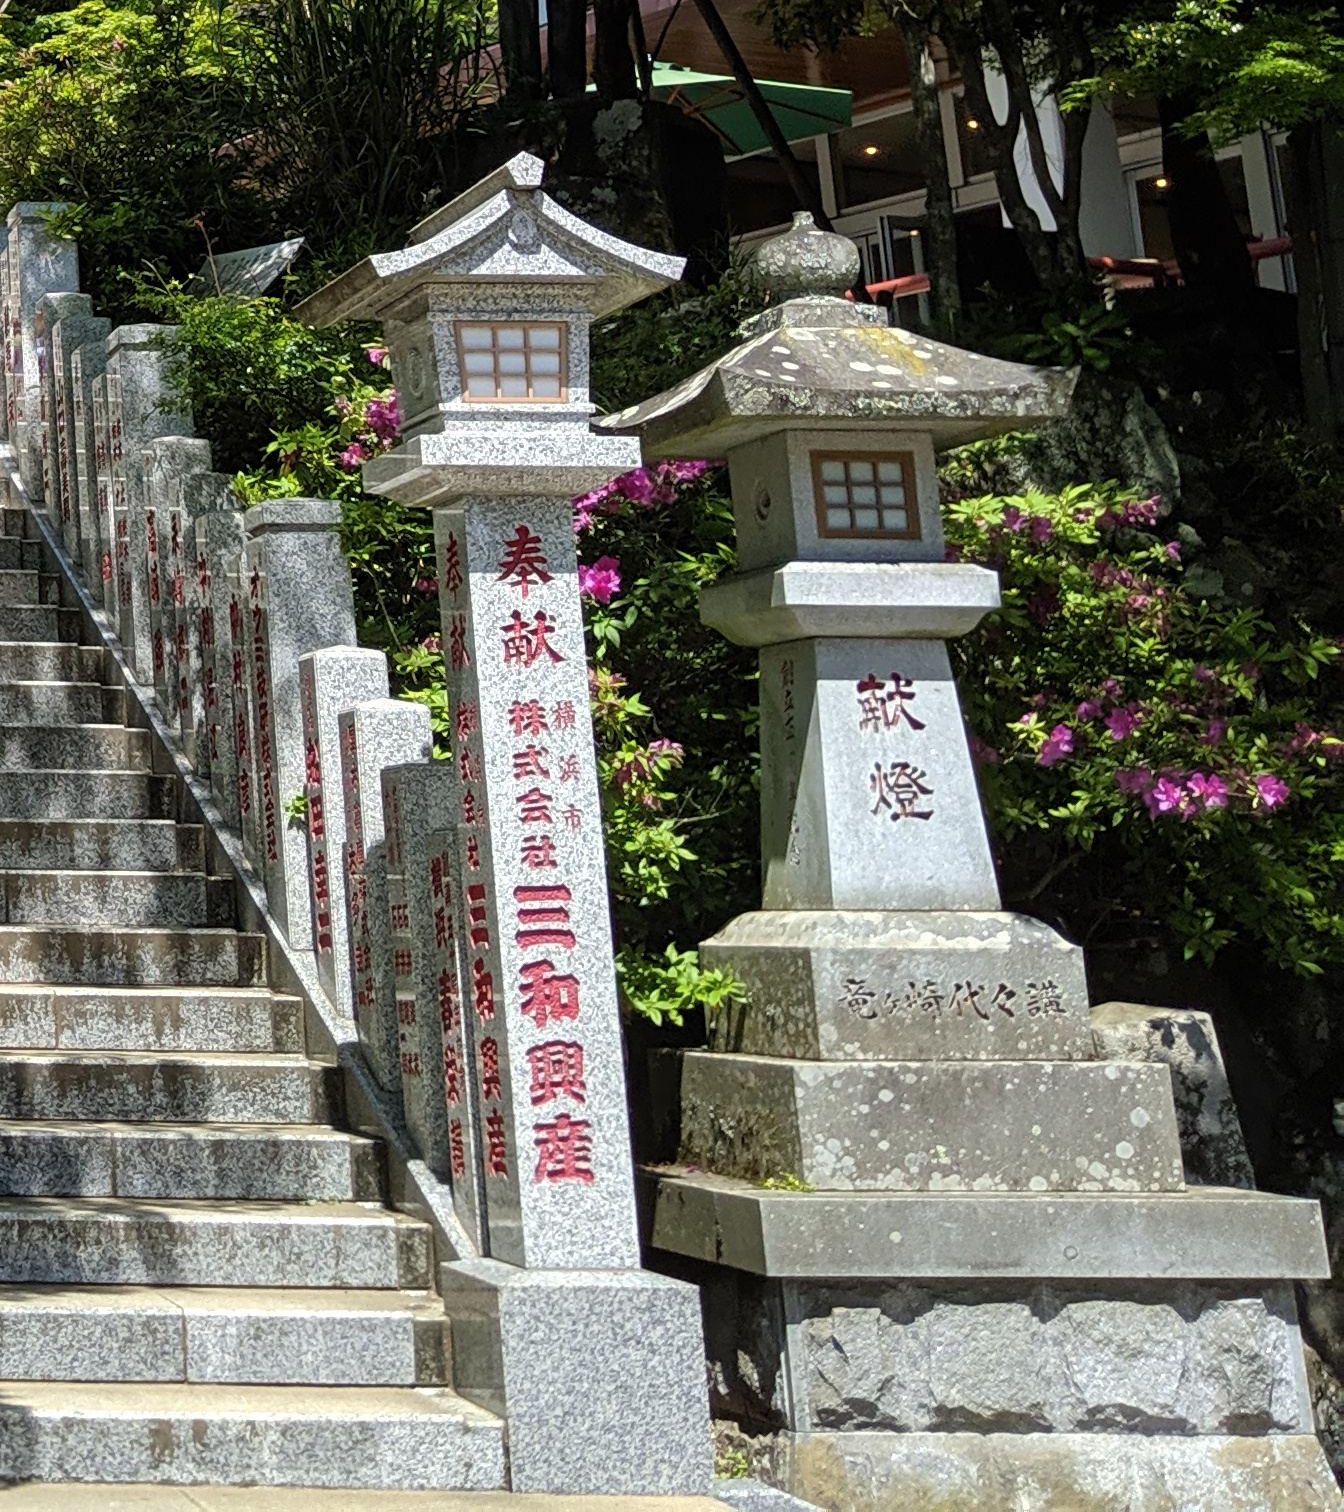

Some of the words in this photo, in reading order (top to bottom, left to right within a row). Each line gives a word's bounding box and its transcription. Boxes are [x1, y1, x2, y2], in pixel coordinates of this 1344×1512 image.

[444, 529, 472, 672] 奉献
[495, 524, 567, 668] 奉献
[550, 699, 585, 836] 横浜市
[456, 700, 481, 874] 株式会社
[507, 697, 558, 870] 株式会社
[855, 671, 936, 823] 献燈
[466, 881, 509, 1181] 三和興産
[512, 884, 595, 1186] 三和興産
